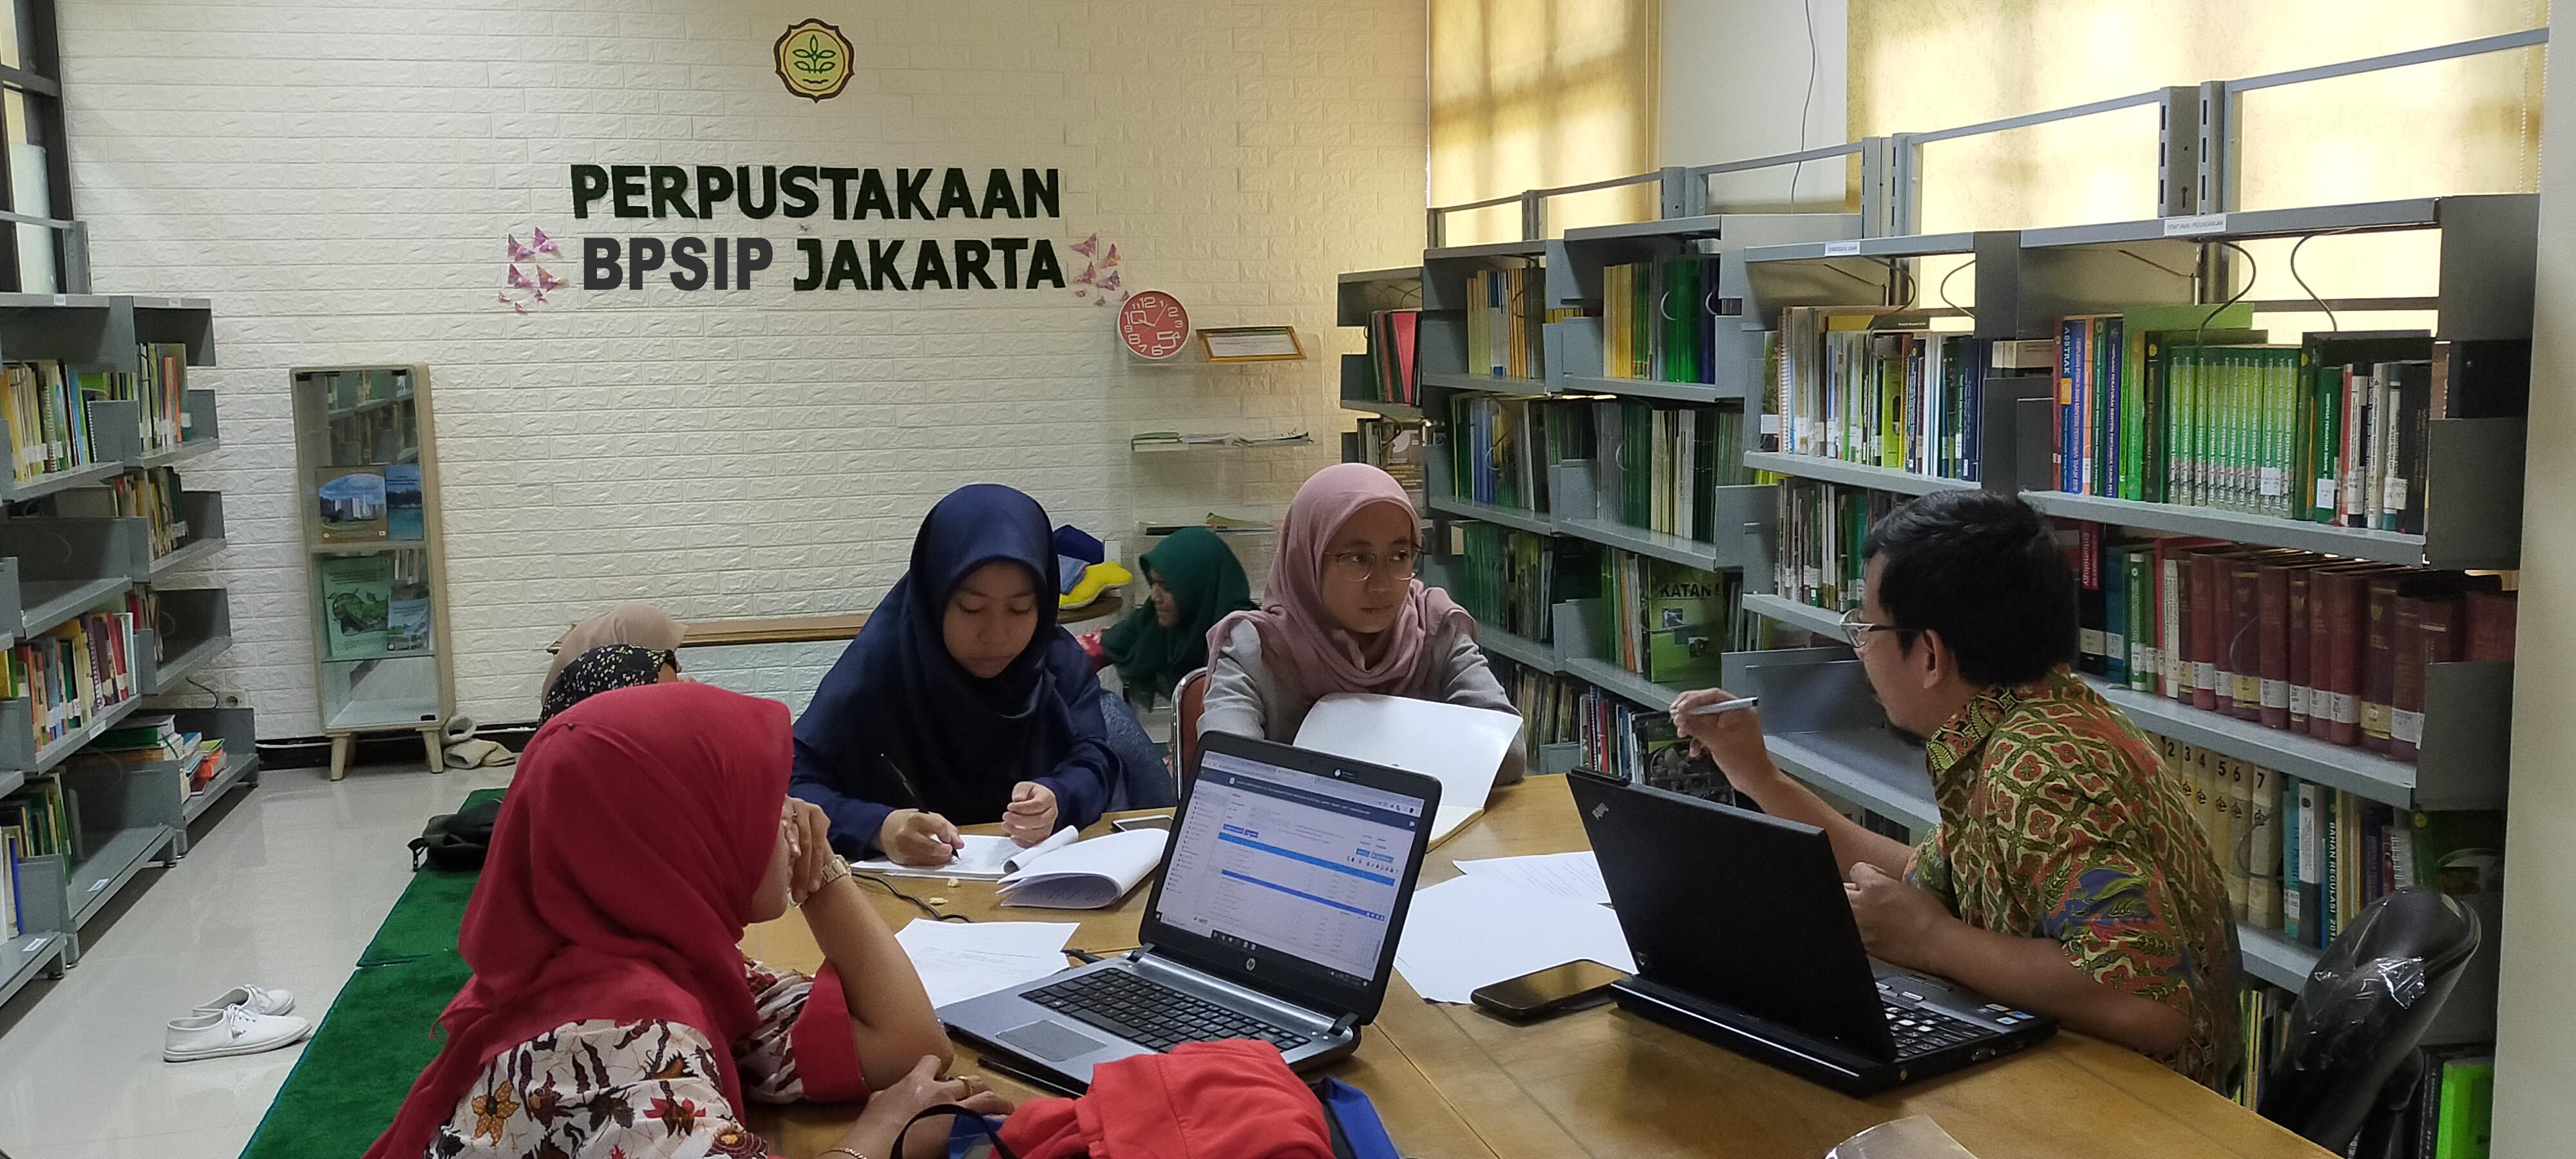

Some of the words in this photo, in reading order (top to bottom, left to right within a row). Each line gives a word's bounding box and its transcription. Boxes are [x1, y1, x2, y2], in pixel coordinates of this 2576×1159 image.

[571, 164, 1060, 220] PERPUSTAKAAN
[583, 237, 773, 290] BPSIP
[793, 238, 1066, 290] JAKARTA
[1139, 297, 1157, 308] 12
[1168, 306, 1179, 317] 2
[1128, 334, 1141, 344] 8
[1151, 344, 1163, 355] 6
[2083, 533, 2091, 586] Entomology
[2168, 742, 2174, 757] 2
[2184, 746, 2191, 761] 3
[2199, 753, 2206, 768] 4
[2218, 760, 2226, 776] 5
[2233, 766, 2241, 782] 6
[2257, 772, 2265, 788] 7
